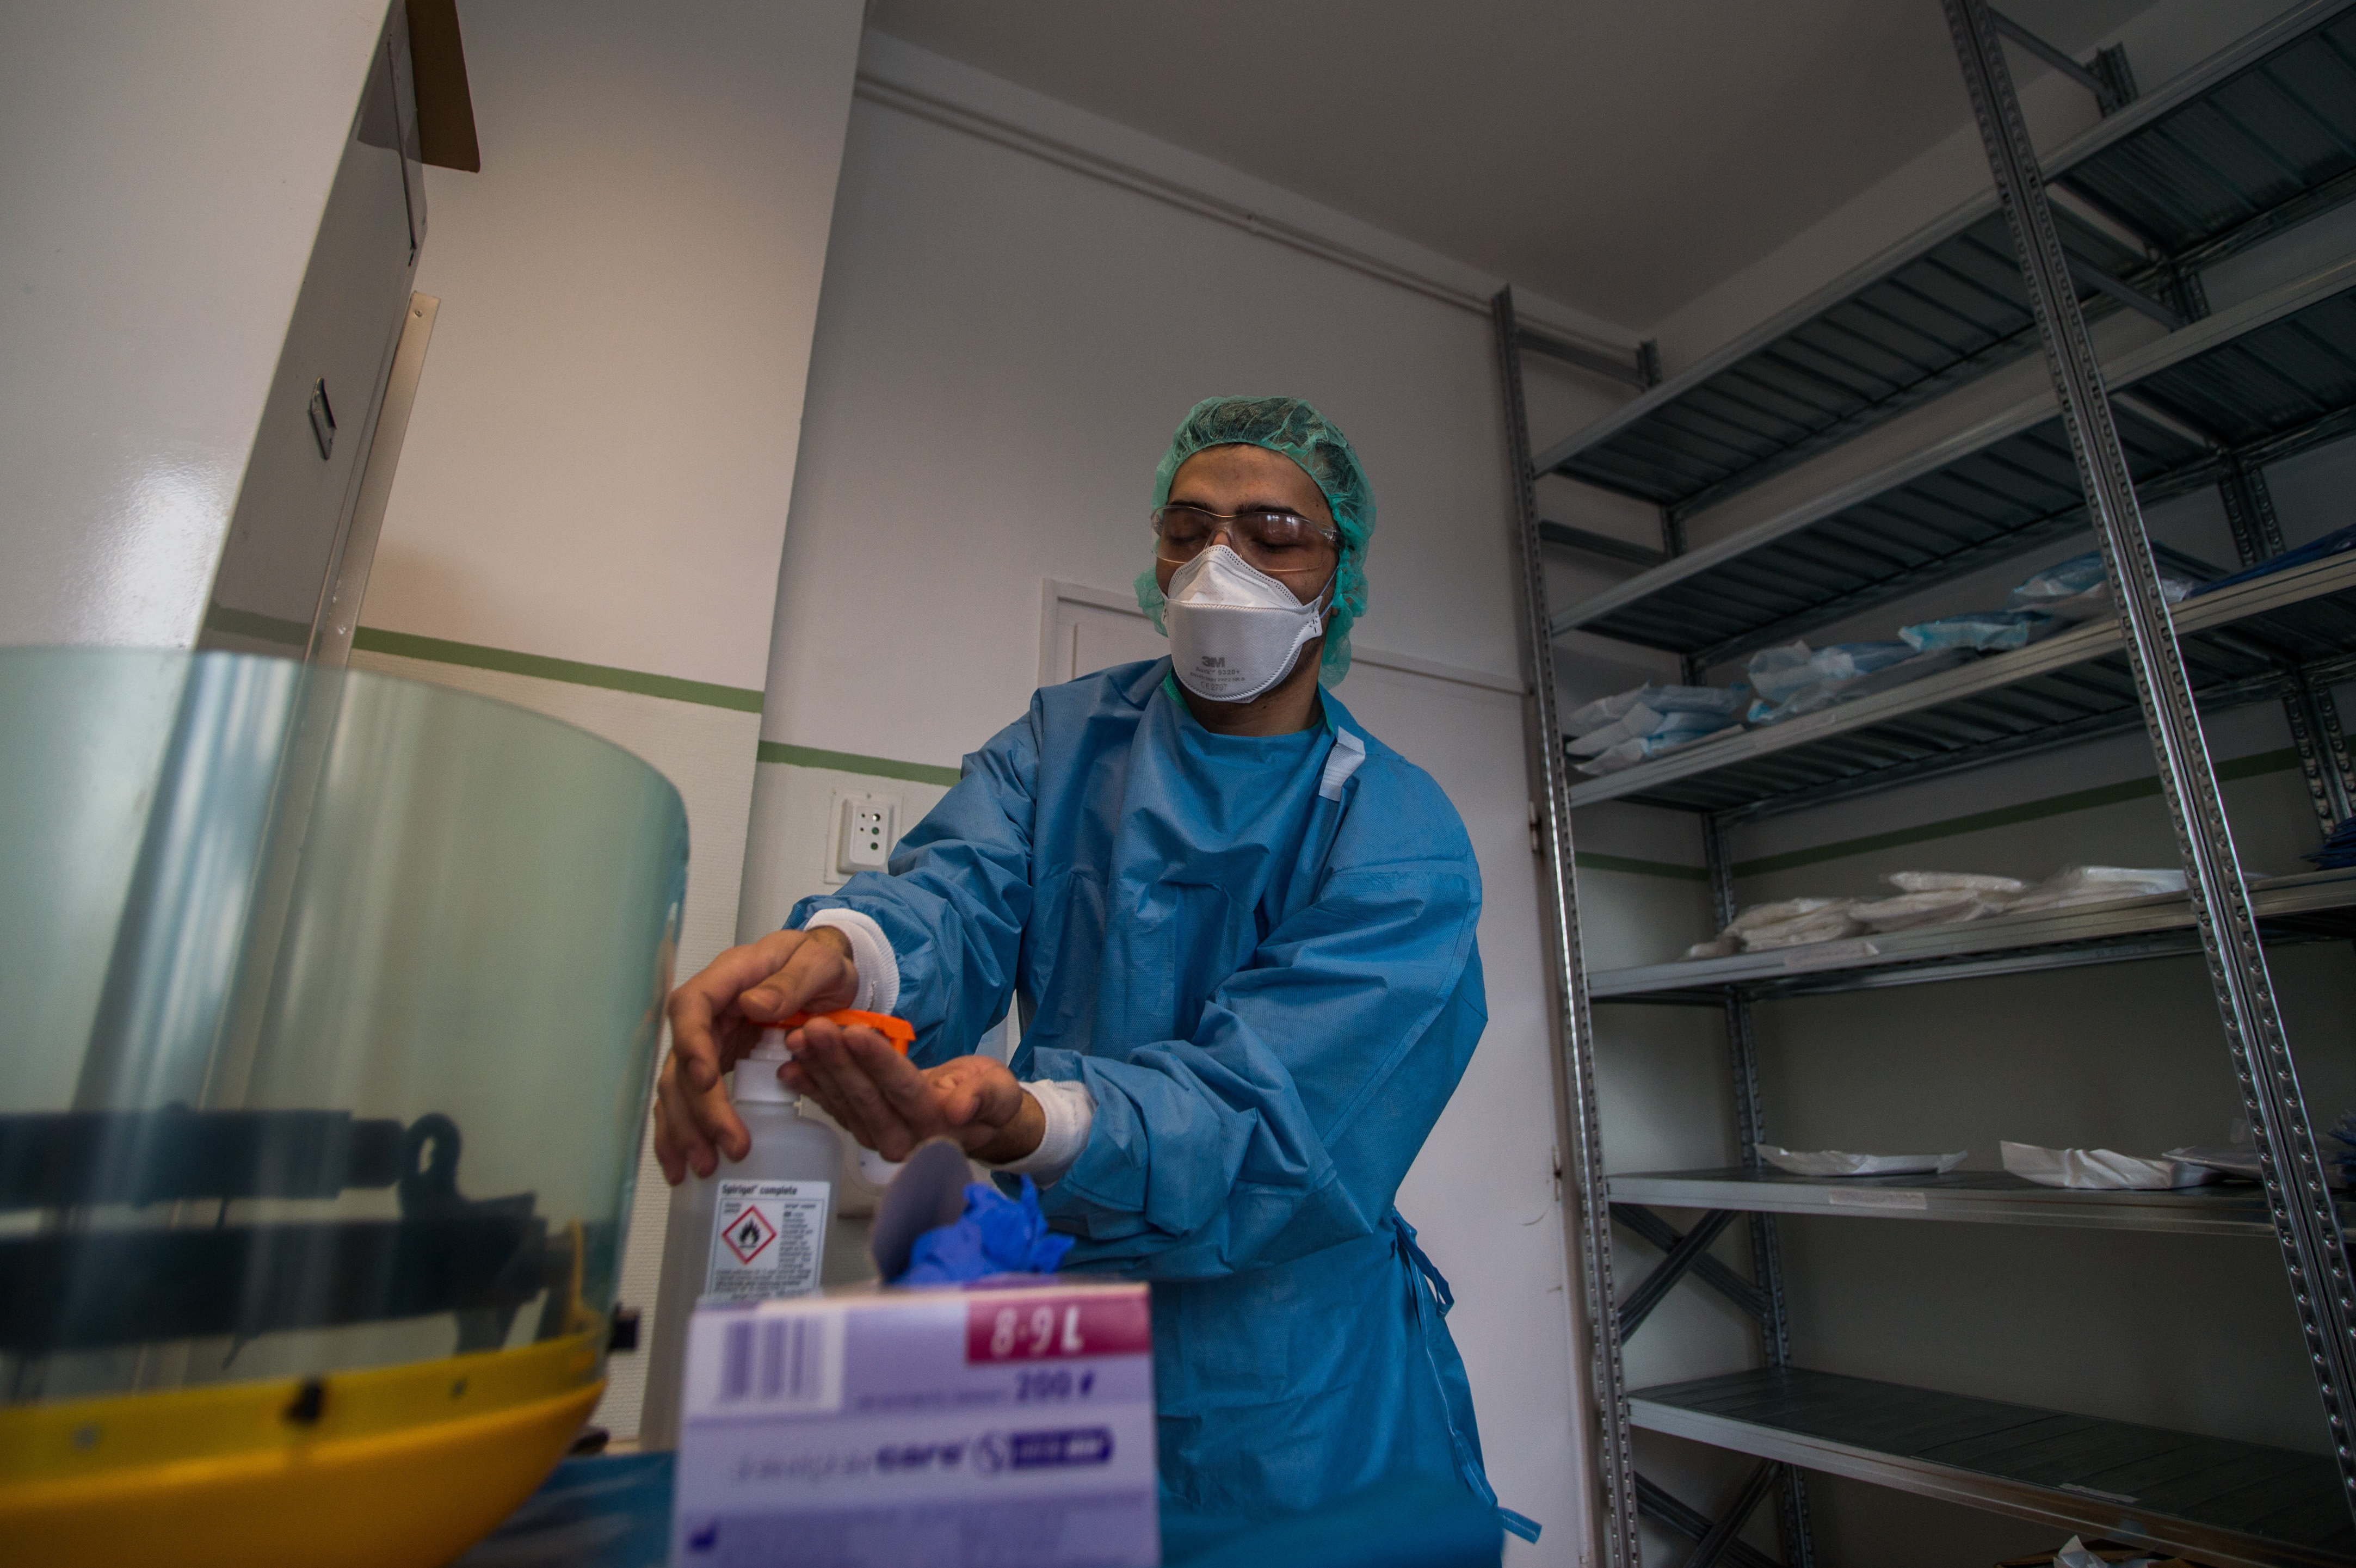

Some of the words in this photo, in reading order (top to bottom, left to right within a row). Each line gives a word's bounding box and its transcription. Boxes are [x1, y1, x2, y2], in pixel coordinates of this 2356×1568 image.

[1201, 656, 1225, 668] 3M
[760, 1186, 797, 1196] complete
[1062, 1305, 1084, 1353] L
[1015, 1369, 1072, 1403] 200
